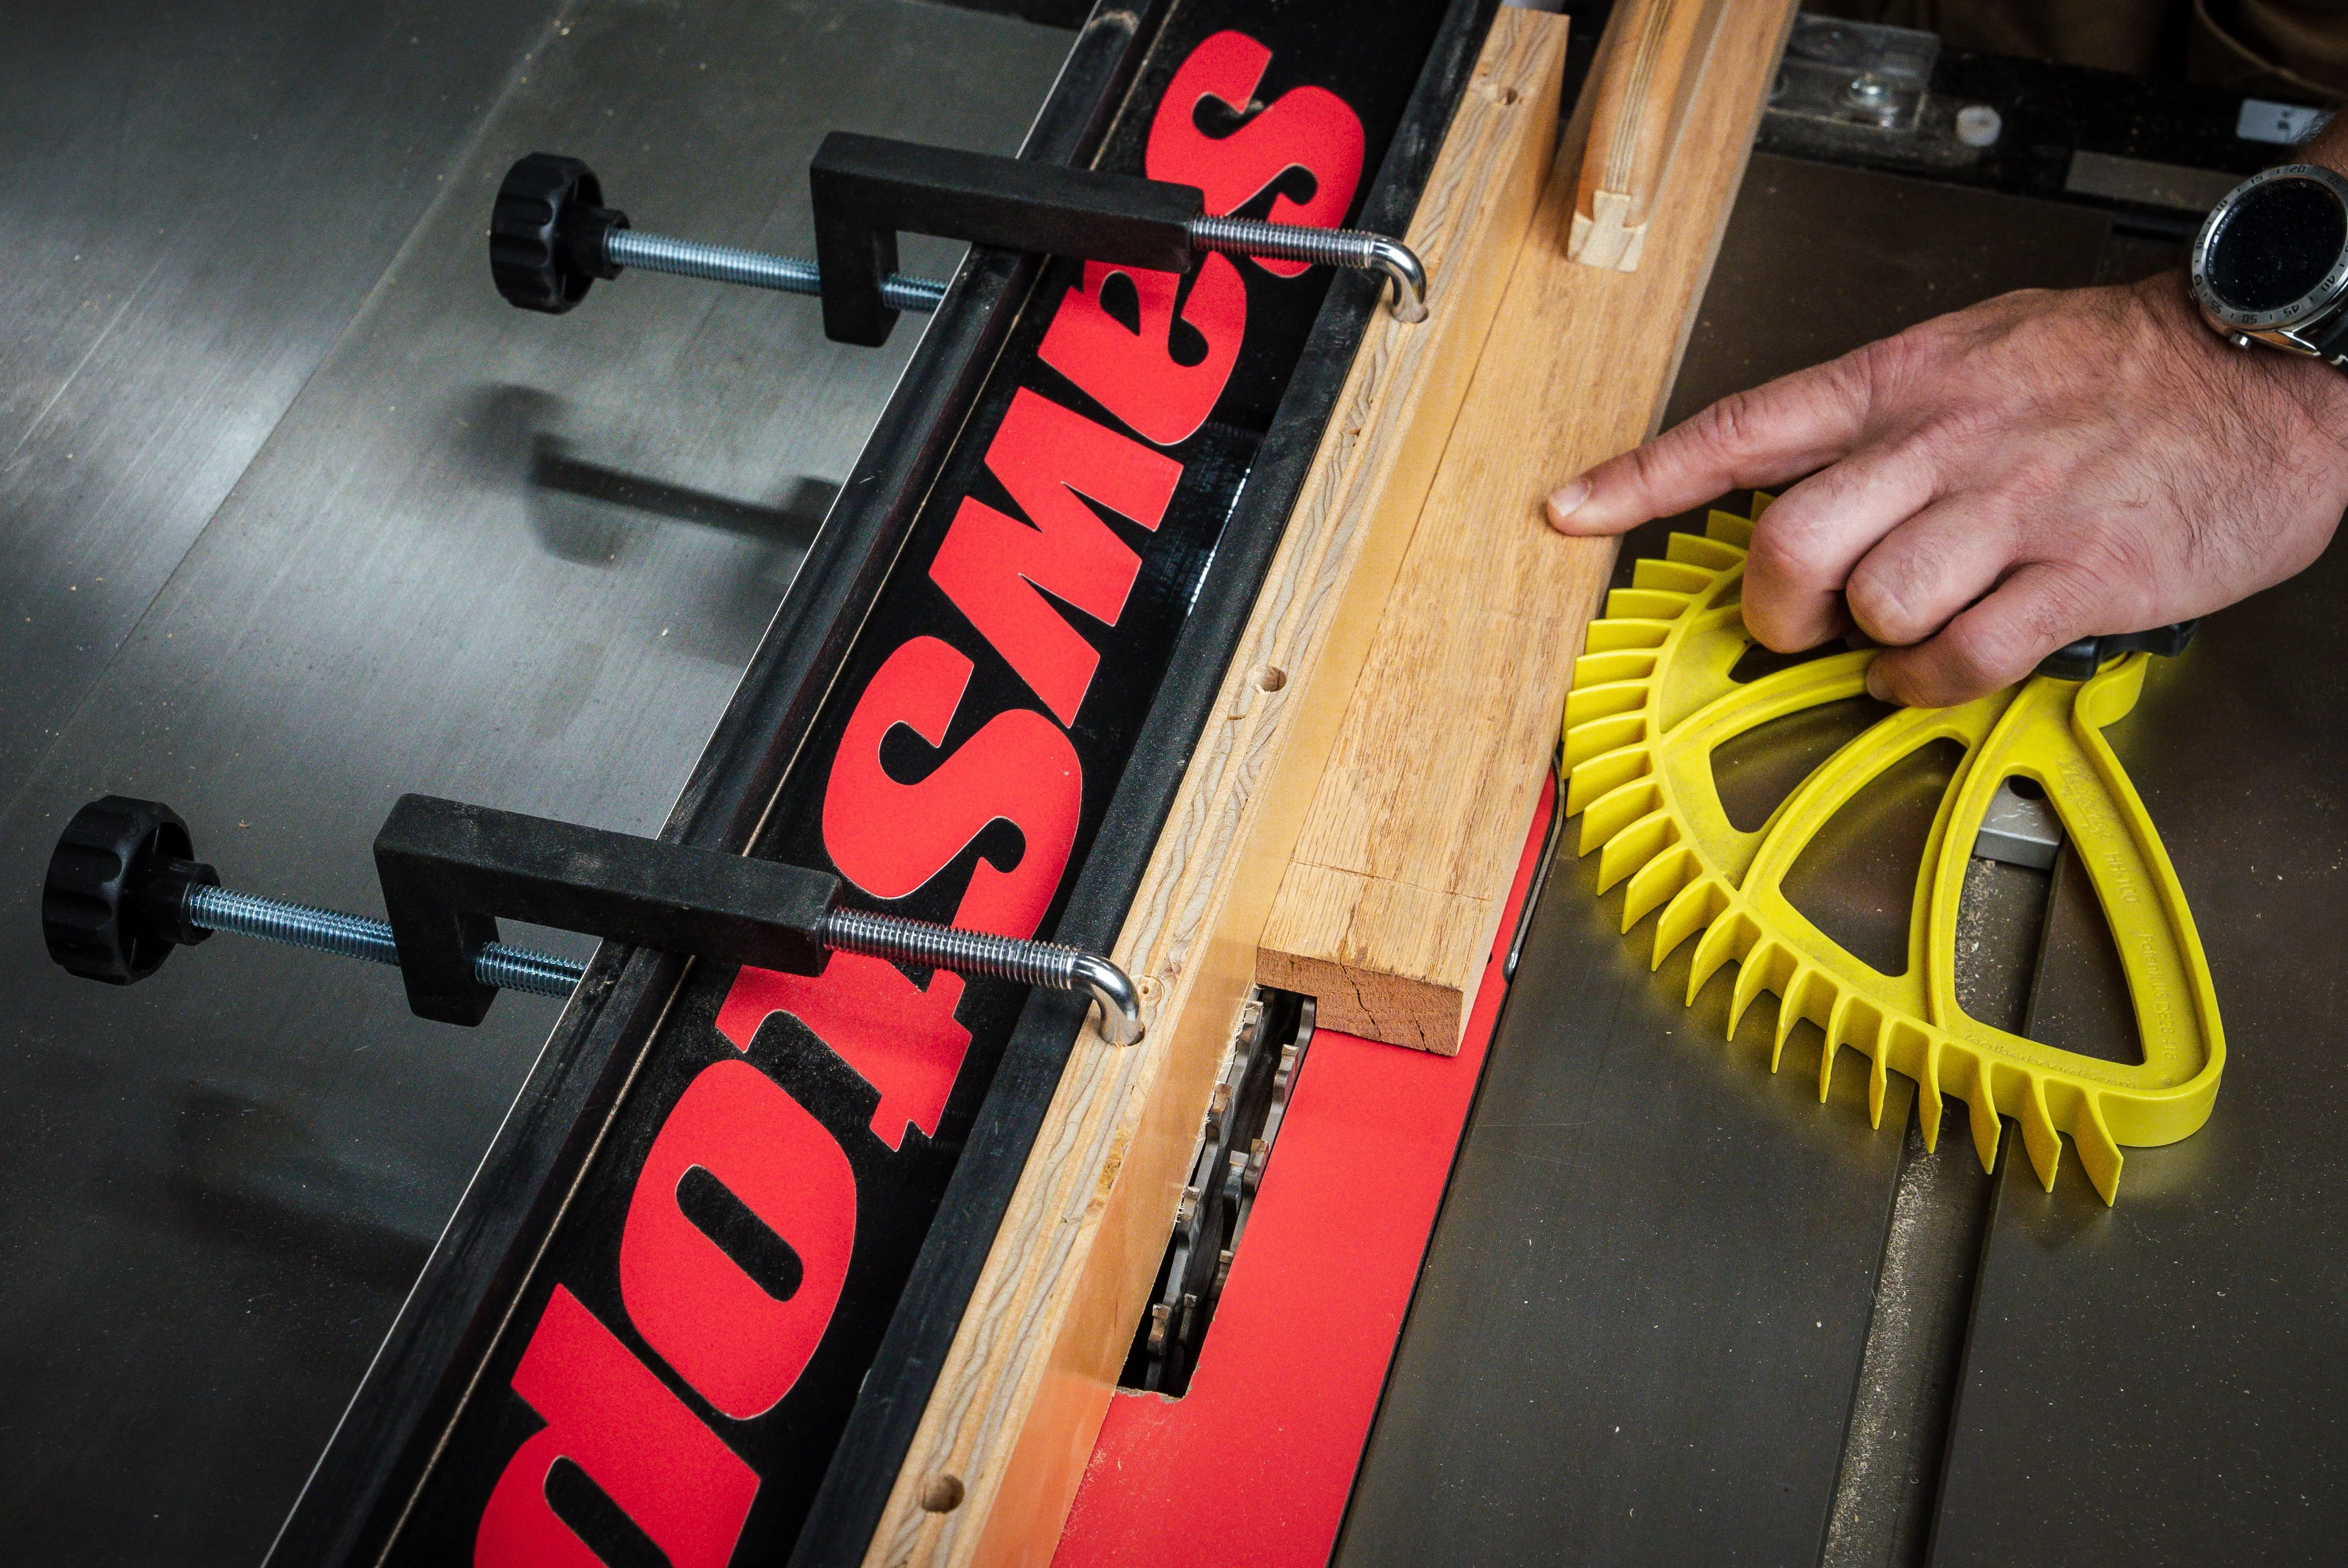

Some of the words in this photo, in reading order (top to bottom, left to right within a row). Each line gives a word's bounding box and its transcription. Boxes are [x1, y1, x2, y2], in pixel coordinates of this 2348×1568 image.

[2326, 175, 2340, 185] 25
[2216, 199, 2229, 212] 10
[2320, 275, 2335, 292] 40
[2209, 300, 2223, 314] 55
[2283, 304, 2300, 317] 45
[2243, 314, 2258, 324] 50
[474, 30, 1365, 1568] SawStop
